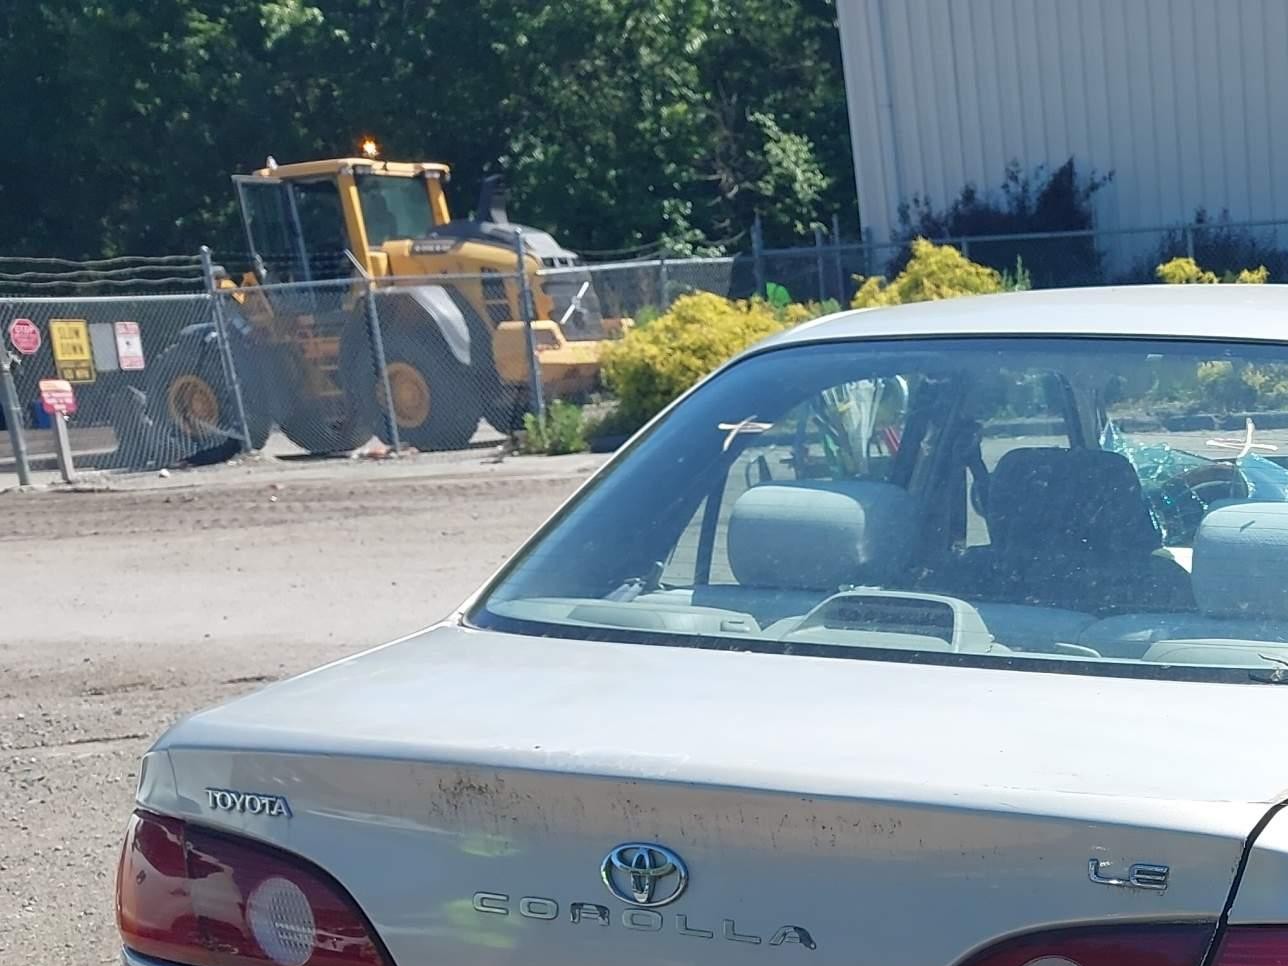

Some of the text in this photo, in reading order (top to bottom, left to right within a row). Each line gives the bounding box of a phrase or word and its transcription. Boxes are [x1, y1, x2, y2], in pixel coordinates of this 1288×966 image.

[203, 788, 293, 817] TOYOTA
[1087, 858, 1170, 891] LE
[472, 891, 817, 950] COROLLA
